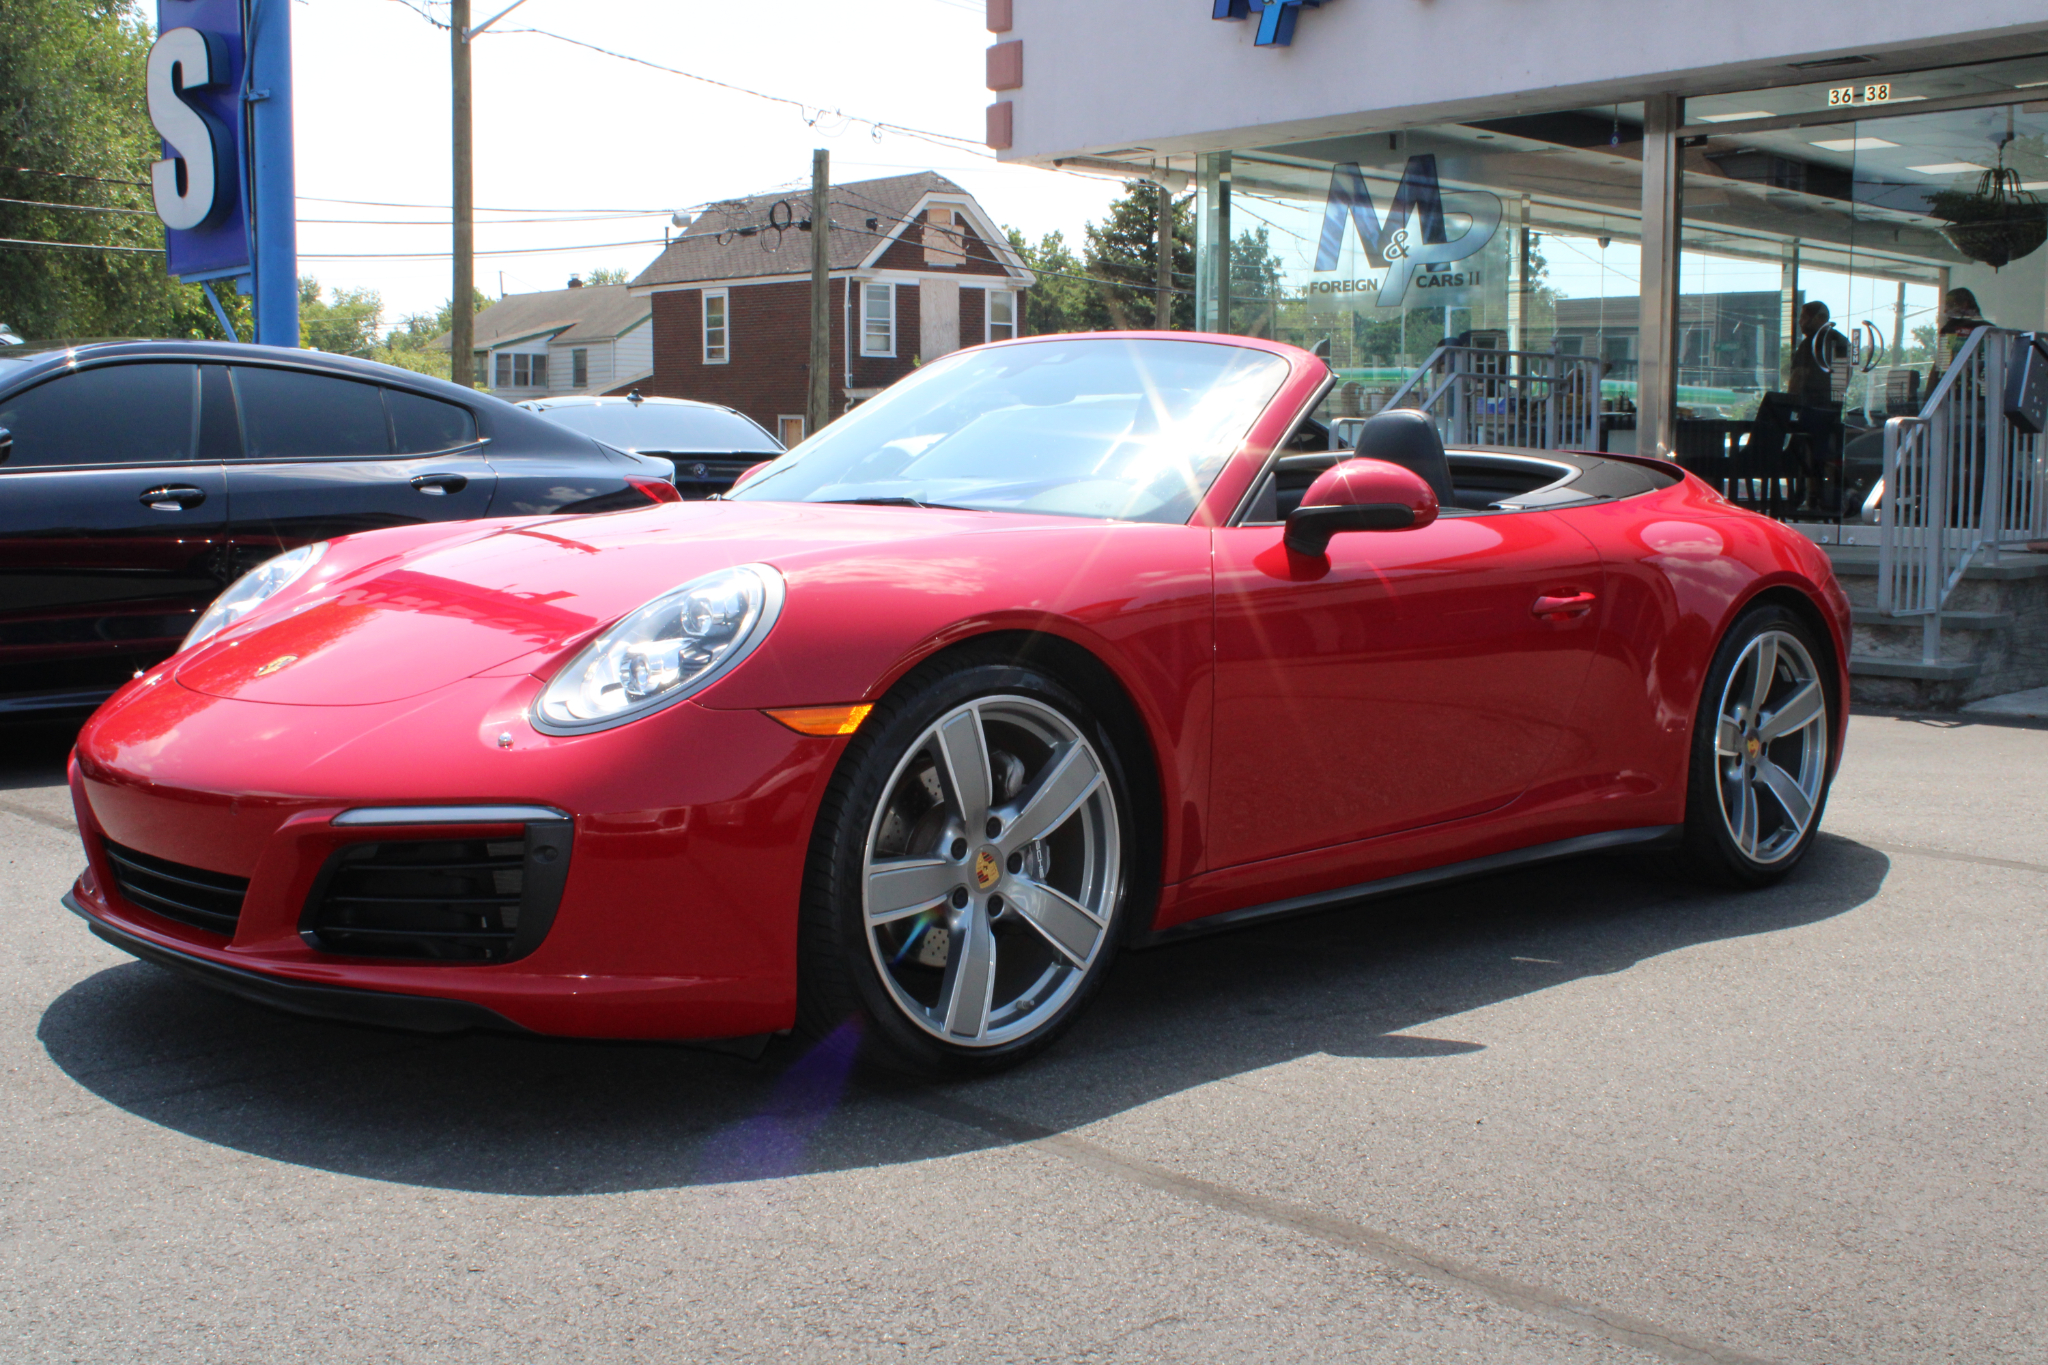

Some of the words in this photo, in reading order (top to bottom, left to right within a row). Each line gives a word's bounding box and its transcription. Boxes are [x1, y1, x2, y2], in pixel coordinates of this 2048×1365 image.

[146, 27, 219, 230] S
[1309, 278, 1378, 294] FOREIGN
[1416, 273, 1464, 289] CARS
[1468, 271, 1481, 286] II
